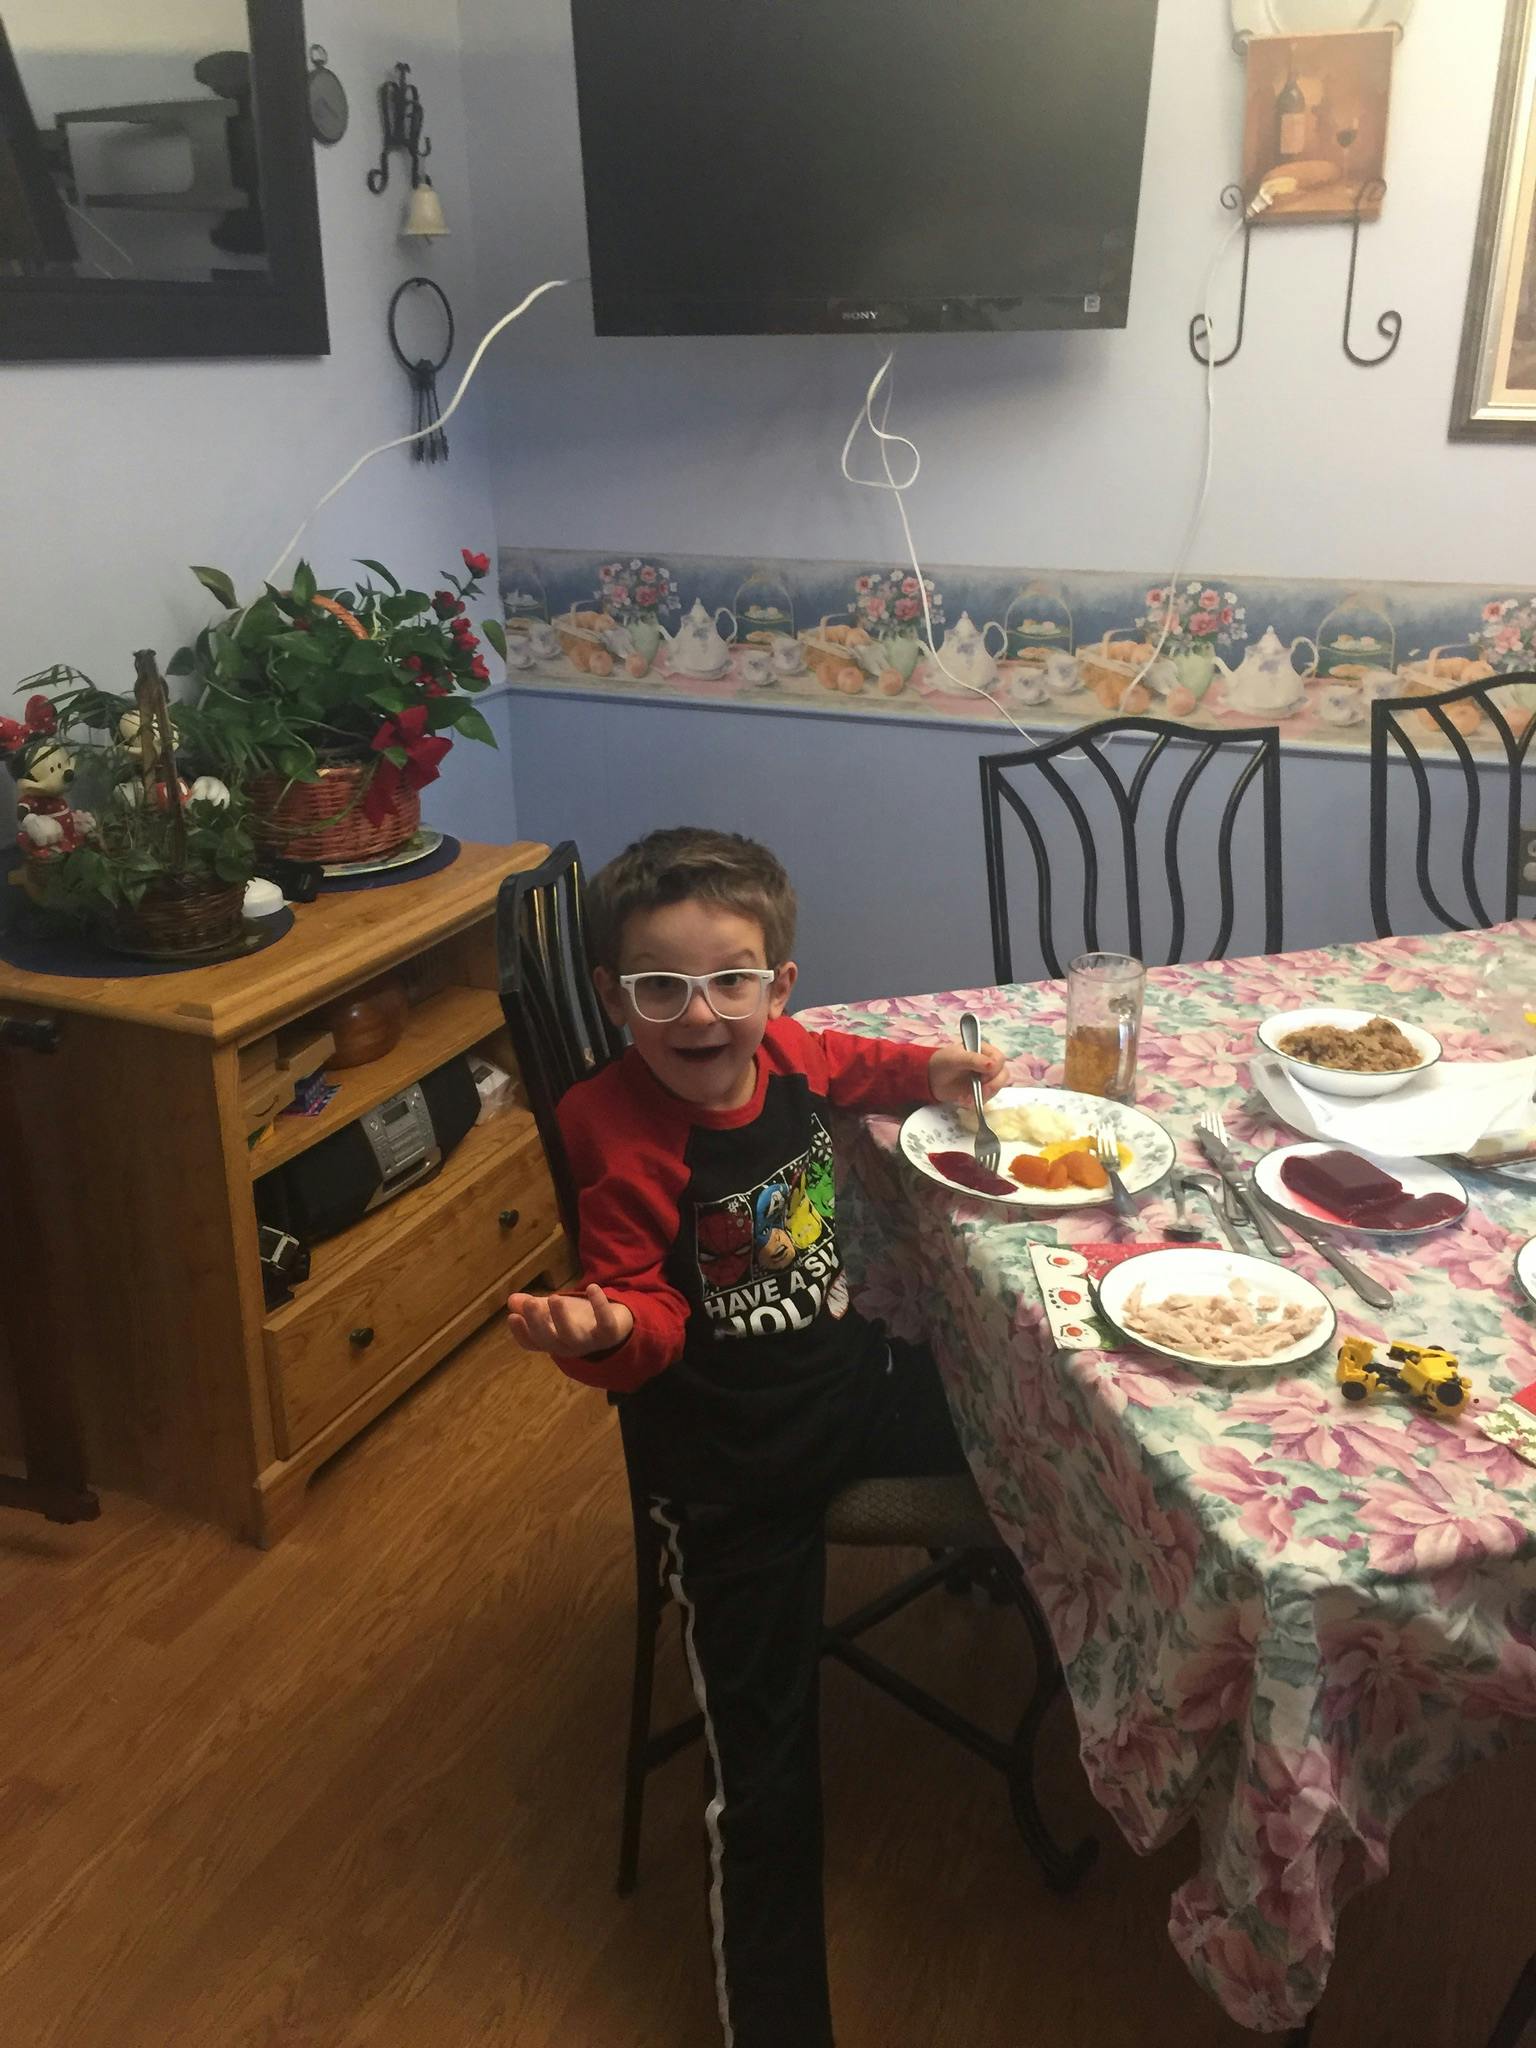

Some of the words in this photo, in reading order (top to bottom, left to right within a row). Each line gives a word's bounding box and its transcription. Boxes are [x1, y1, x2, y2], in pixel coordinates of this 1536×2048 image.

[841, 310, 878, 320] SONY
[704, 1278, 781, 1320] HAVE
[790, 1270, 807, 1294] A
